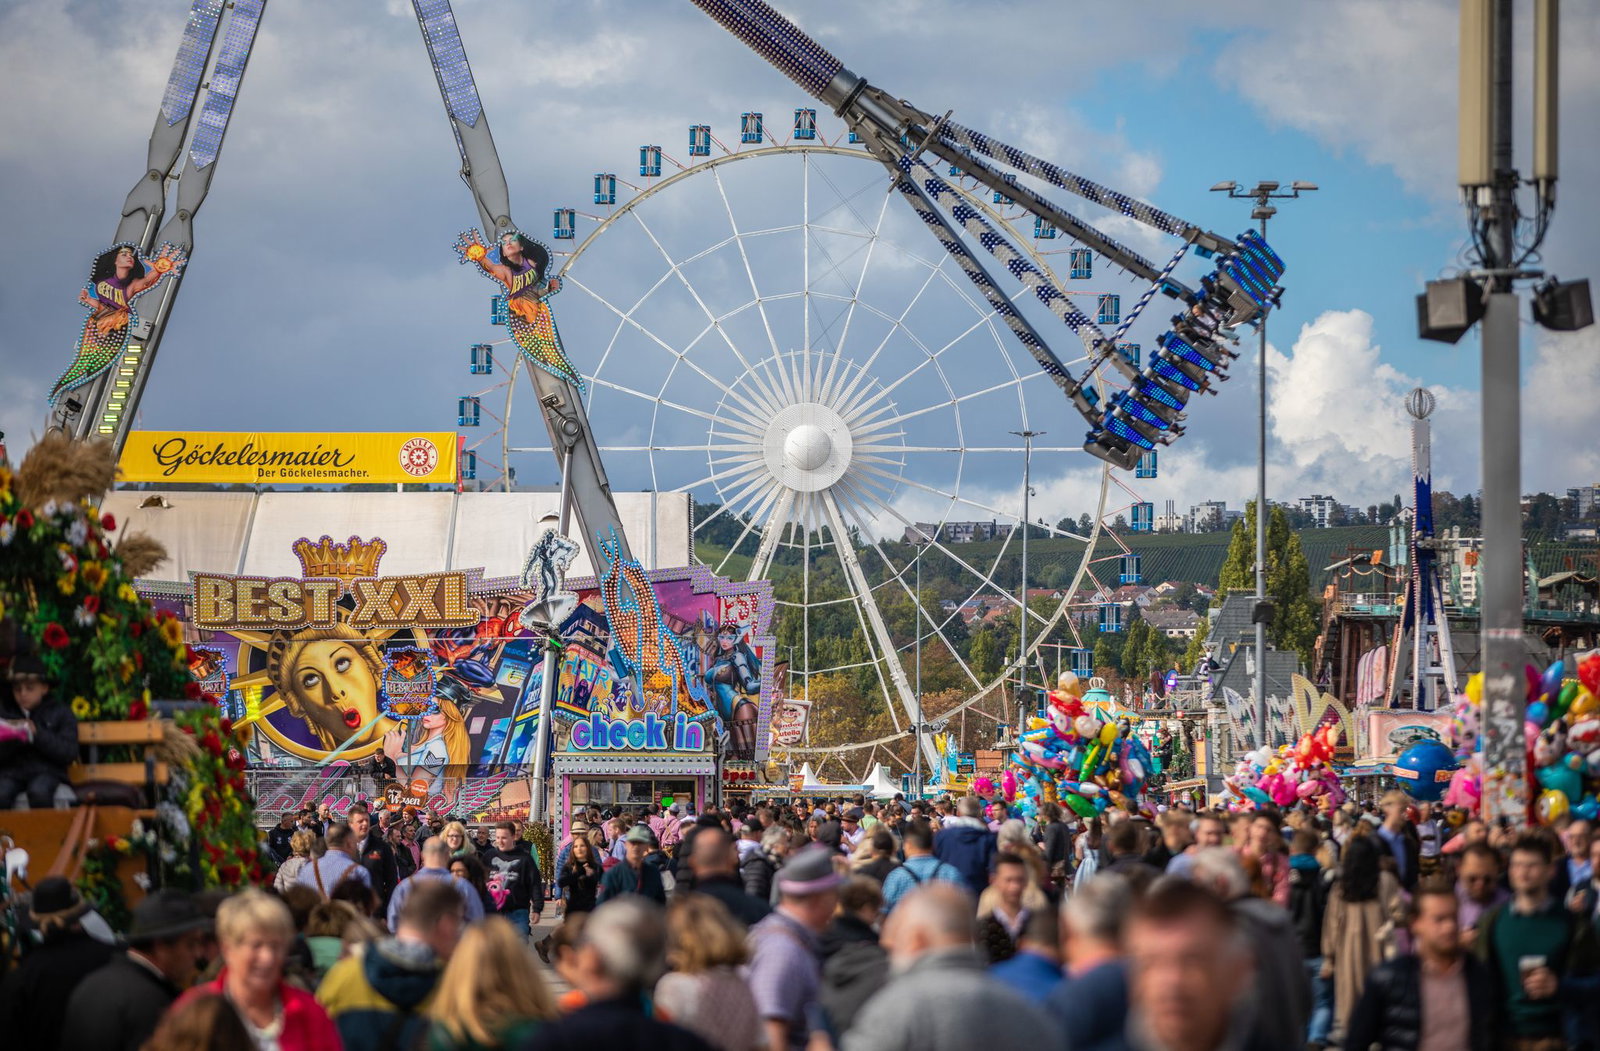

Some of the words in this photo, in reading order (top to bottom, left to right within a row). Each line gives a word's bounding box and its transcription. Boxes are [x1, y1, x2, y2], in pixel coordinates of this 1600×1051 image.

[403, 439, 433, 452] WULLE
[152, 438, 356, 476] Göckelesmaier
[258, 468, 276, 477] Der
[280, 467, 370, 478] Göckelesmacher.
[403, 462, 433, 475] BIERE
[311, 563, 364, 576] THE
[199, 577, 338, 624] BEST
[355, 575, 477, 622] XXL
[571, 712, 667, 750] check
[674, 712, 705, 751] in
